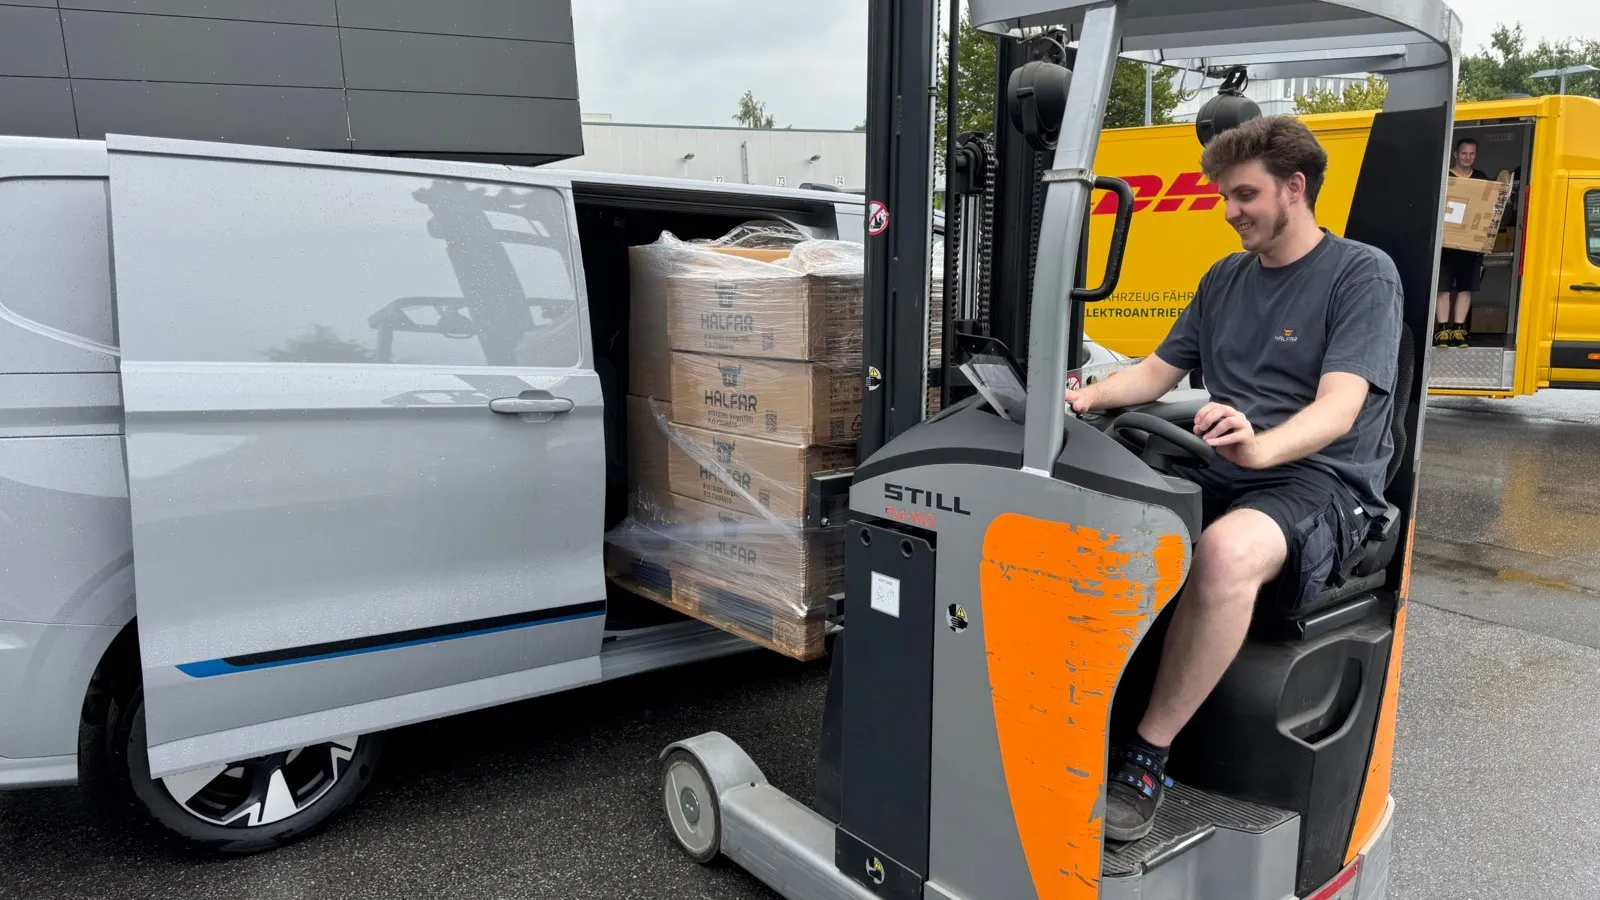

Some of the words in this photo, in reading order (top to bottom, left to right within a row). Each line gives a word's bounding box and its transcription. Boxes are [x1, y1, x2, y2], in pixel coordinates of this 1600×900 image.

[777, 176, 786, 186] 73
[836, 176, 844, 186] 74
[1091, 171, 1222, 215] DH
[1102, 291, 1160, 302] HRZEUG
[1163, 290, 1195, 302] FÄHR
[700, 313, 753, 332] HALFAR
[1086, 308, 1184, 318] LEKTROANTRIE
[704, 389, 757, 413] HALFAR
[884, 482, 971, 515] STILL
[705, 540, 757, 566] HALFAR
